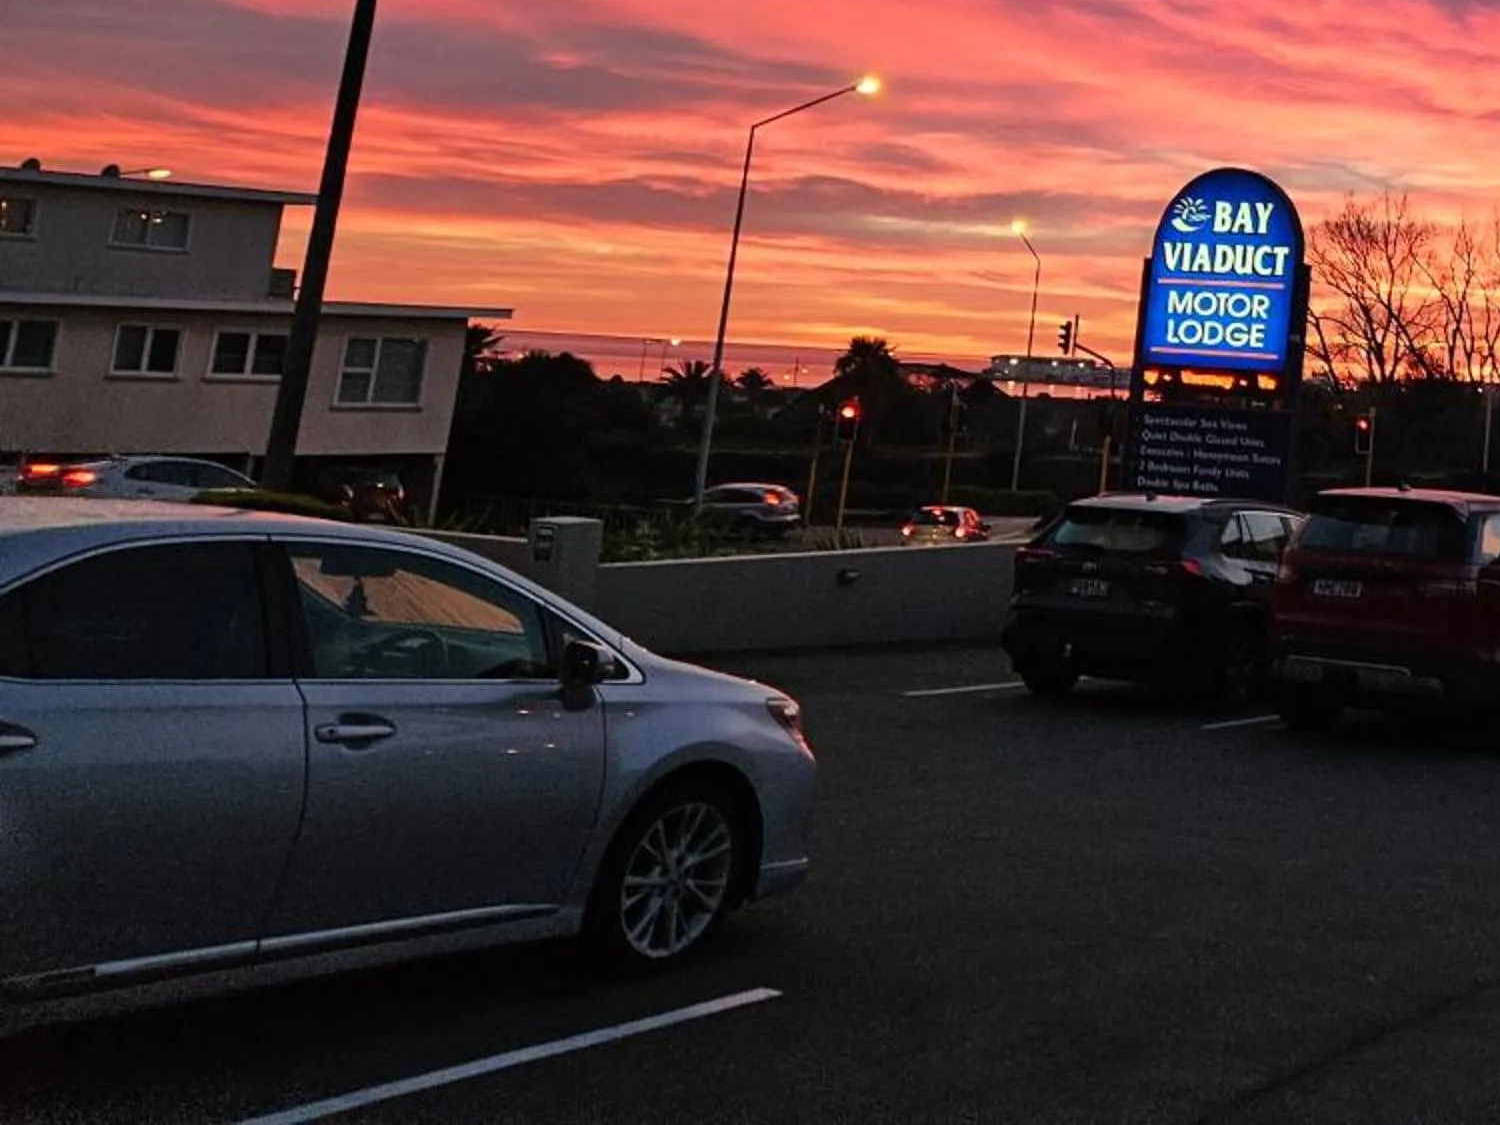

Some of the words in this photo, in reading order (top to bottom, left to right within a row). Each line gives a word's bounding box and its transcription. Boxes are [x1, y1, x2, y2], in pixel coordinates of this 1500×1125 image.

[1212, 199, 1274, 235] BAY
[1163, 241, 1290, 277] VIADUCT
[1167, 290, 1271, 320] MOTOR
[1166, 318, 1266, 348] LODGE
